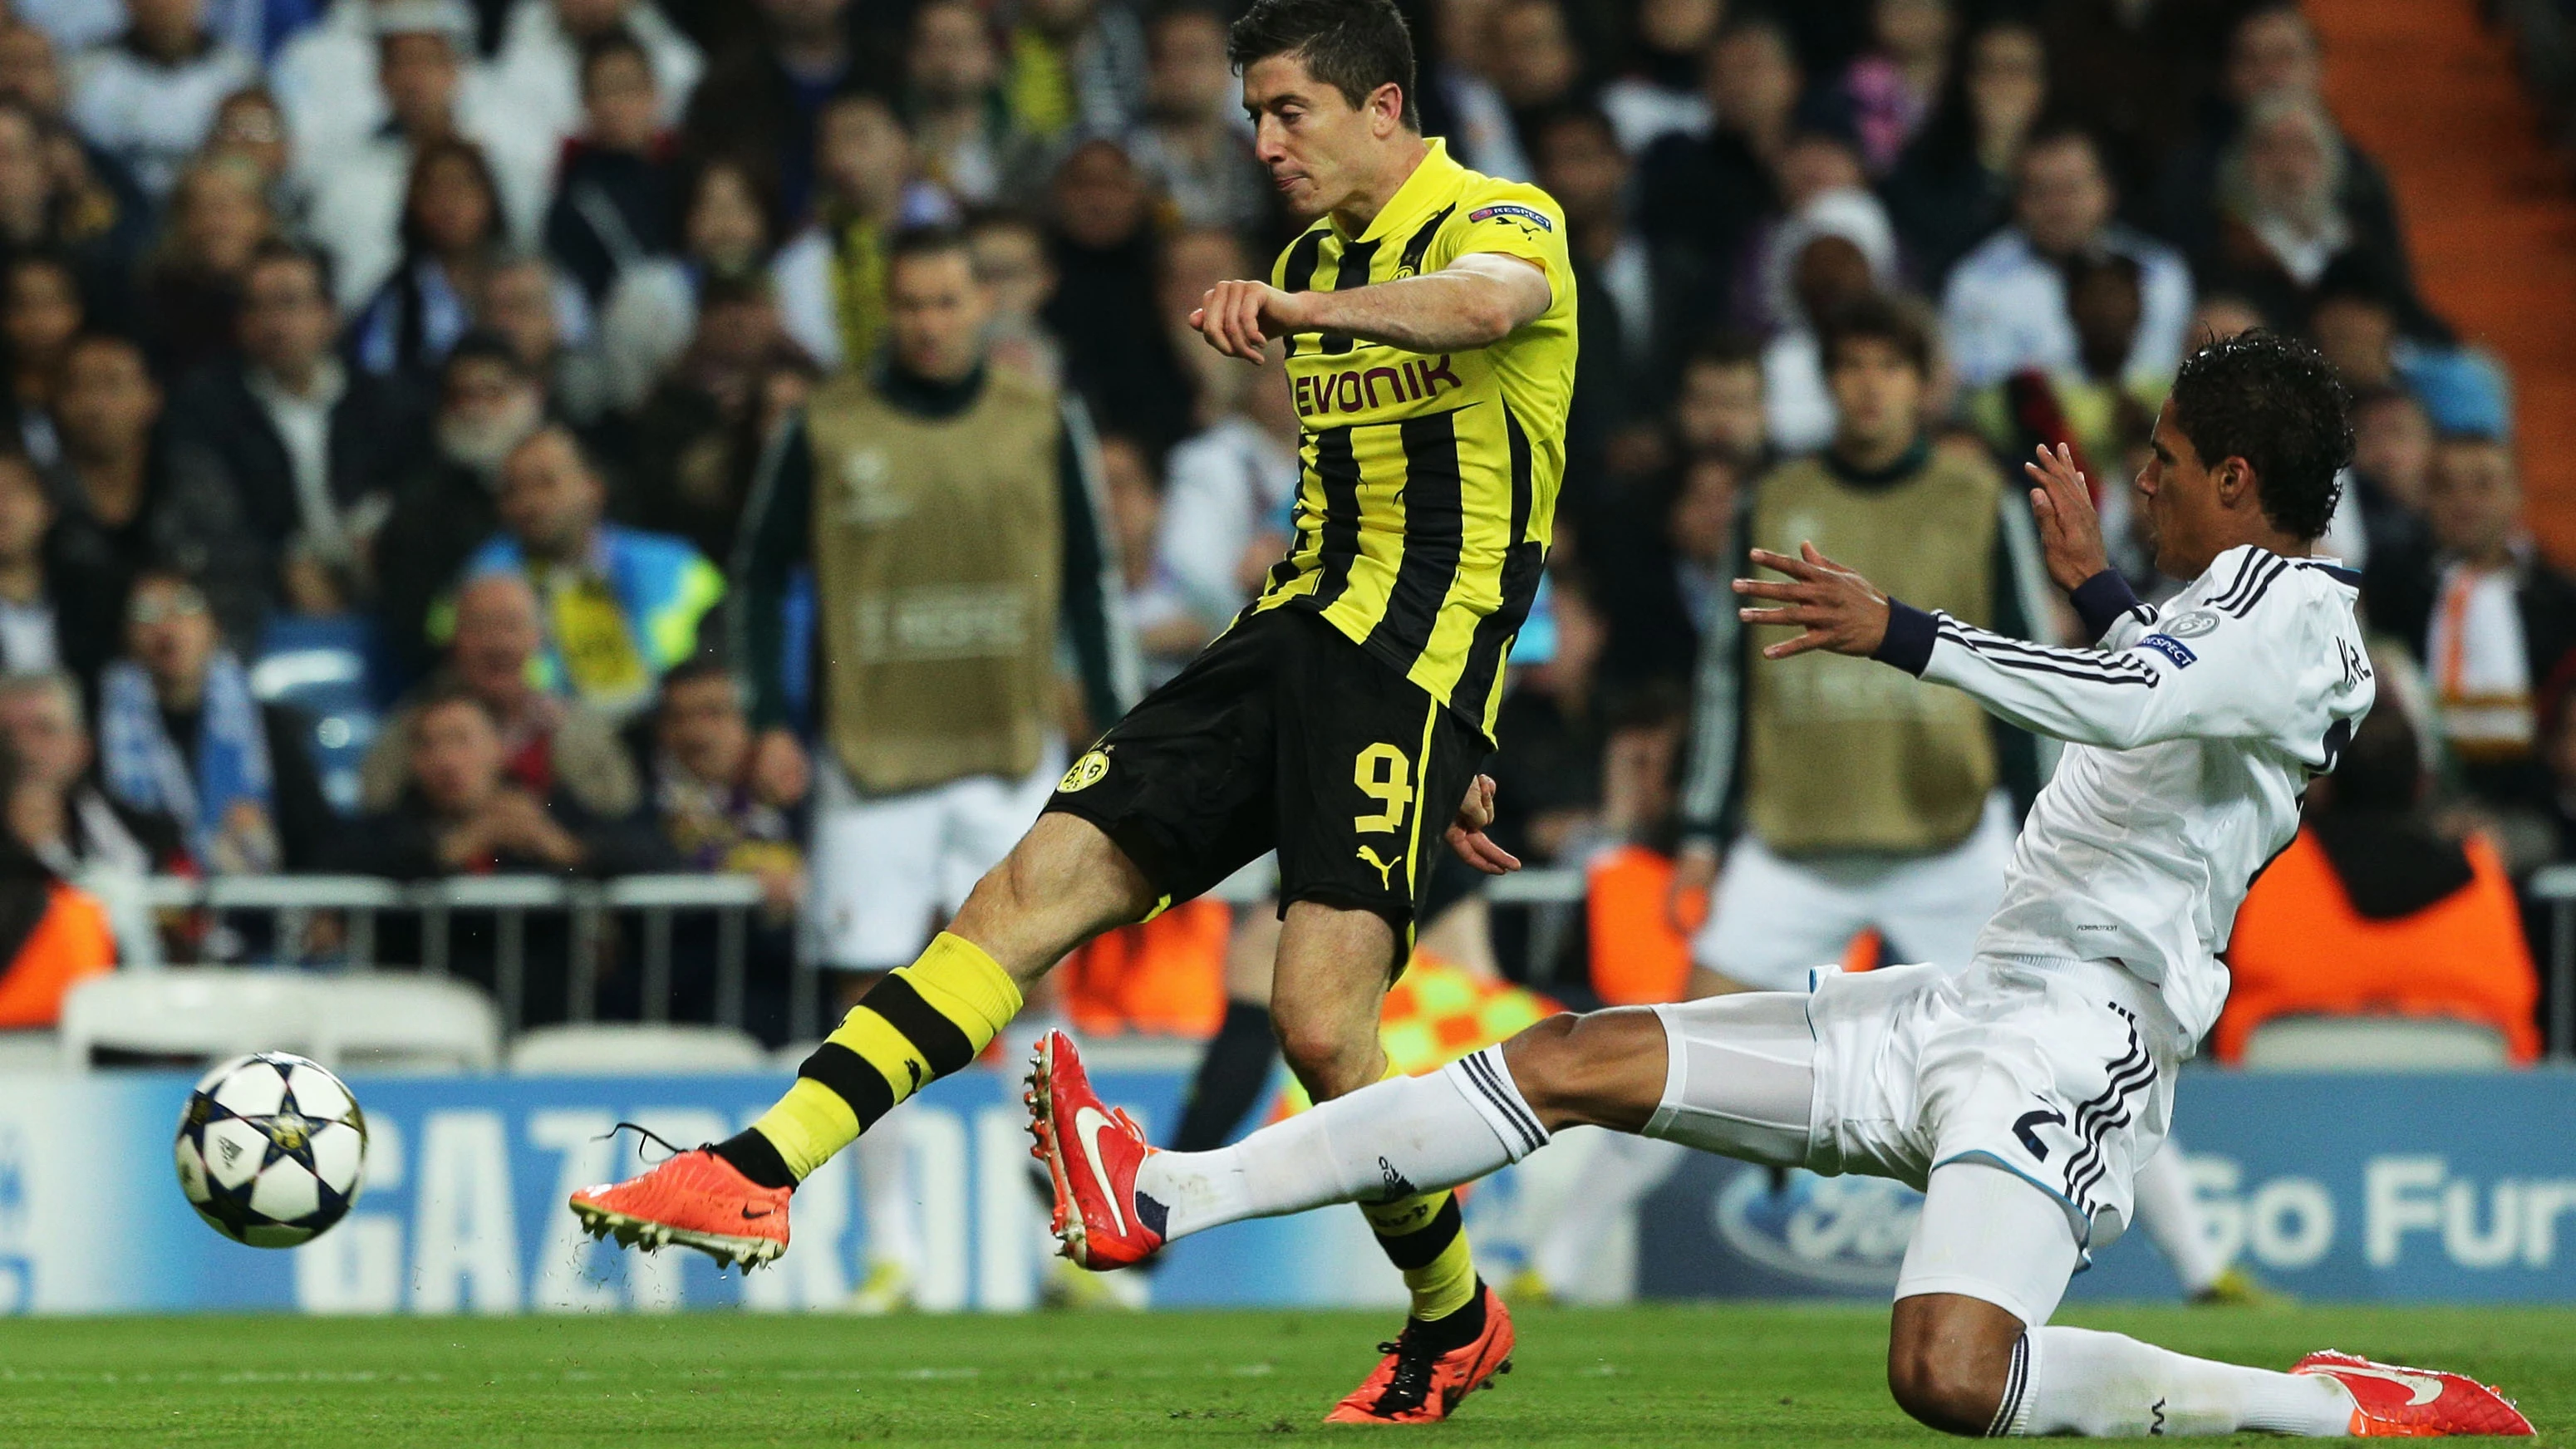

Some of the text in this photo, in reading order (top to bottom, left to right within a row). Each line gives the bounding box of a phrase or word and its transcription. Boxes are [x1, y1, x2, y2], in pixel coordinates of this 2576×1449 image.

[1493, 205, 1551, 229] RESPECT
[1295, 353, 1463, 418] EVONIK
[1354, 742, 1413, 833] 9
